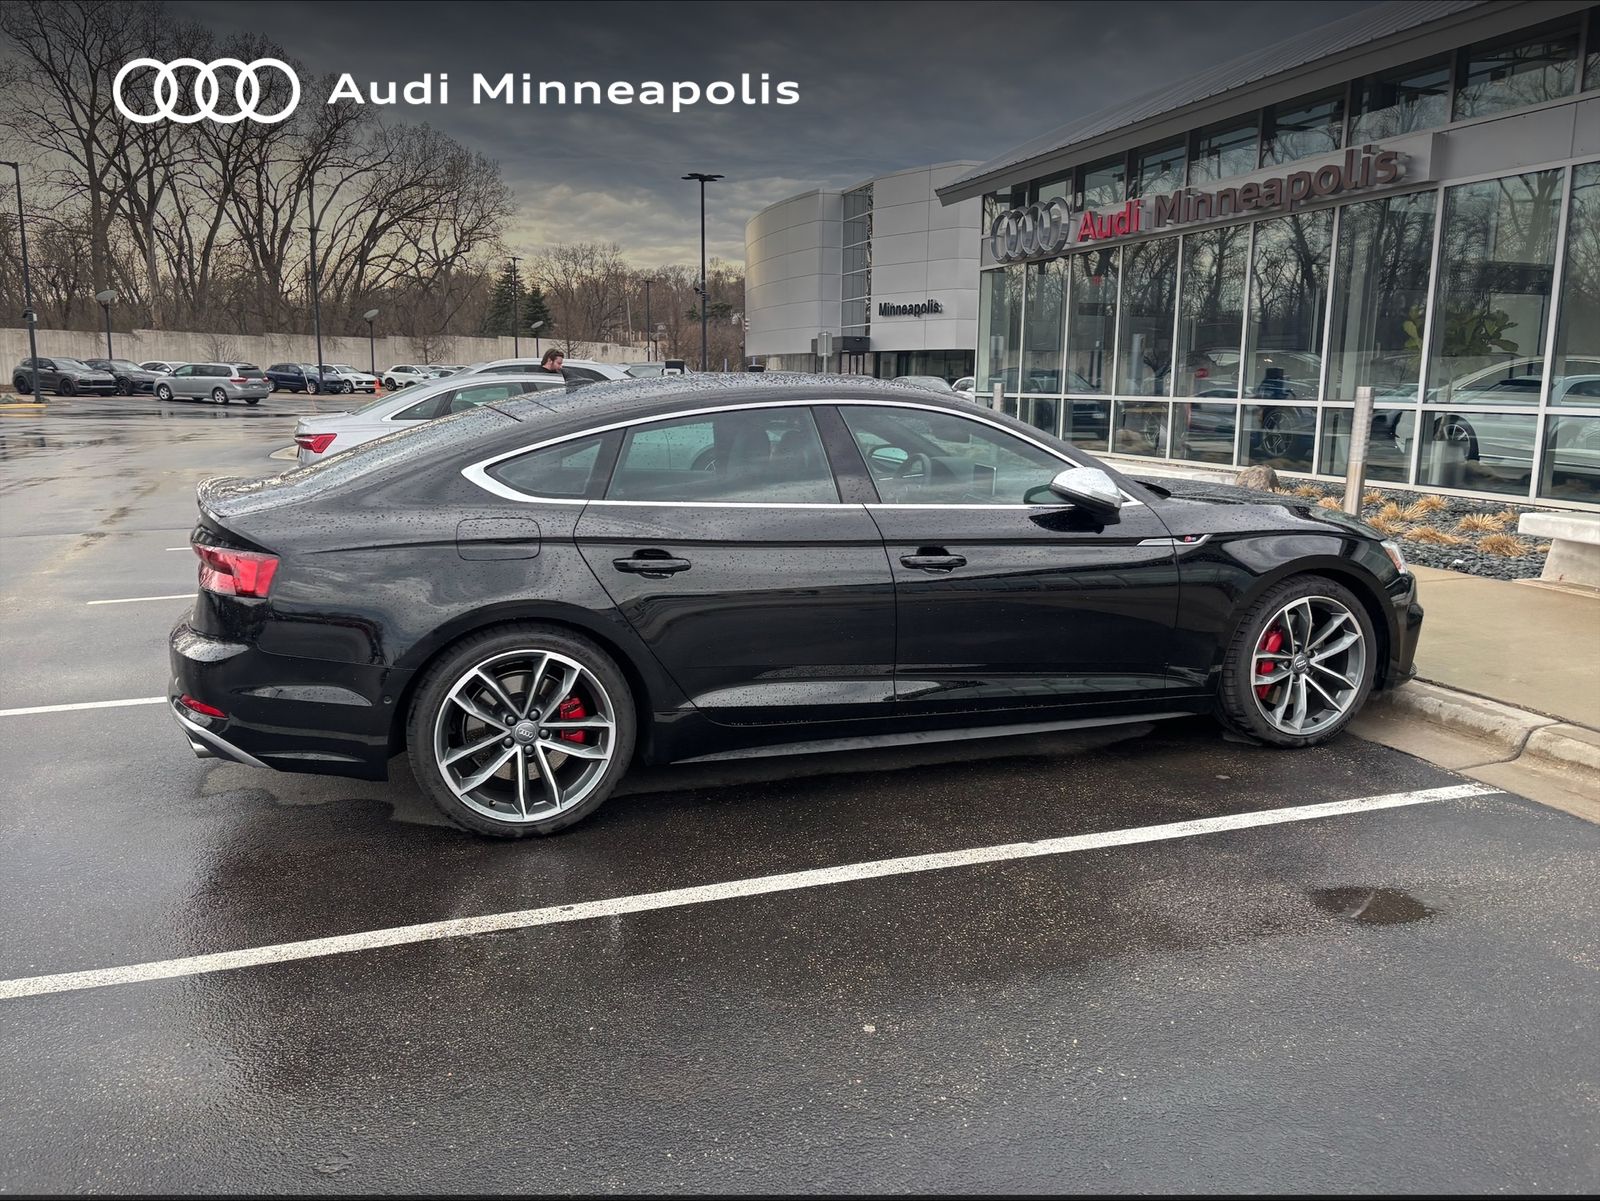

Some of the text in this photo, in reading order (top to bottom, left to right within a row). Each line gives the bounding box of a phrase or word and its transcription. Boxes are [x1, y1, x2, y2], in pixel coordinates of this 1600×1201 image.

[1077, 144, 1399, 243] Audi Minneapolis
[878, 299, 942, 317] Minneapolis
